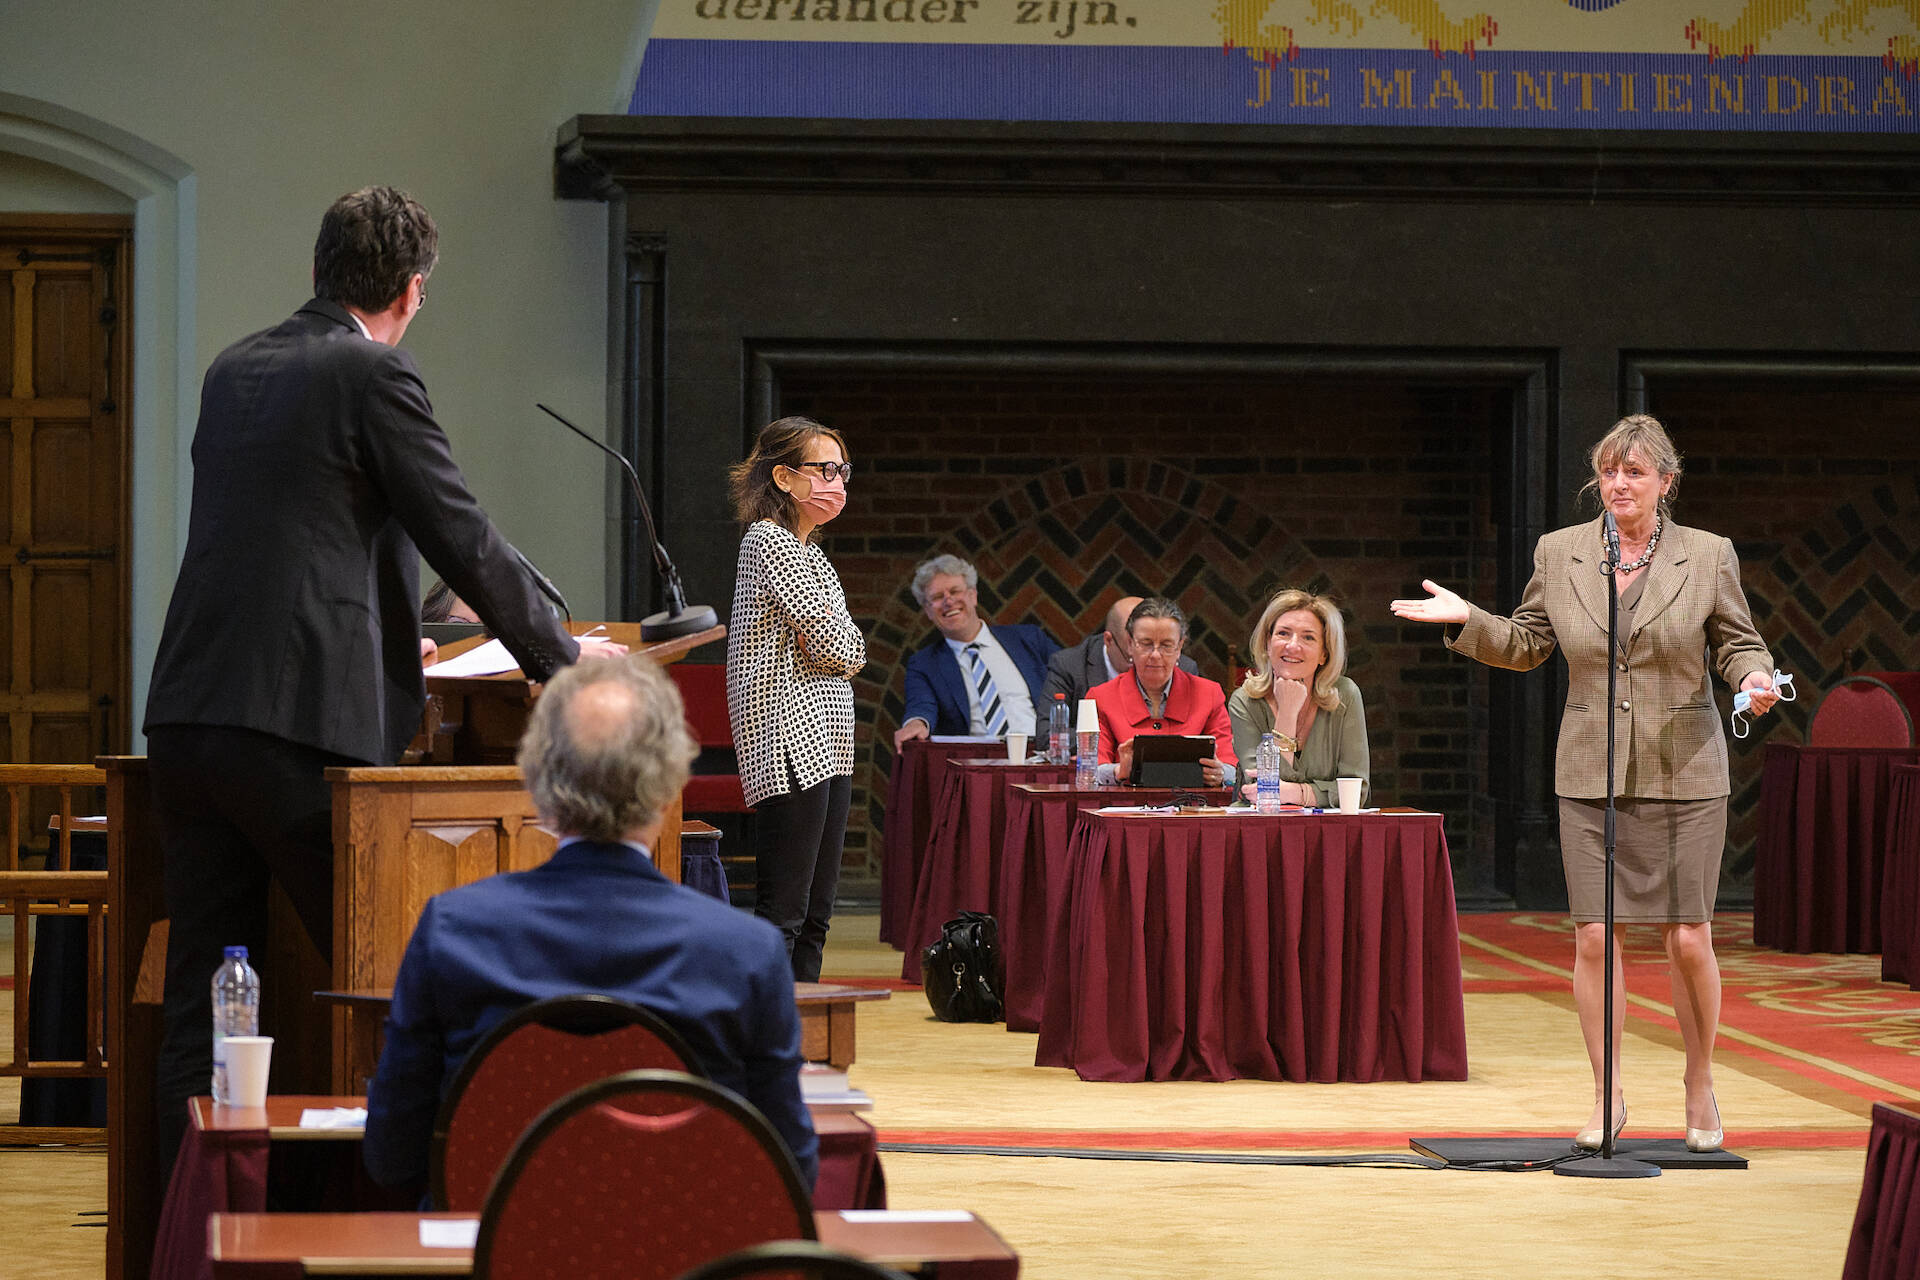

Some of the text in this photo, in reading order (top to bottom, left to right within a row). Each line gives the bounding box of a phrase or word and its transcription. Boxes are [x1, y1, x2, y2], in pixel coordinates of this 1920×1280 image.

[1016, 0, 1137, 38] zijn.
[1247, 66, 1920, 116] JE MAINTIENDRA
